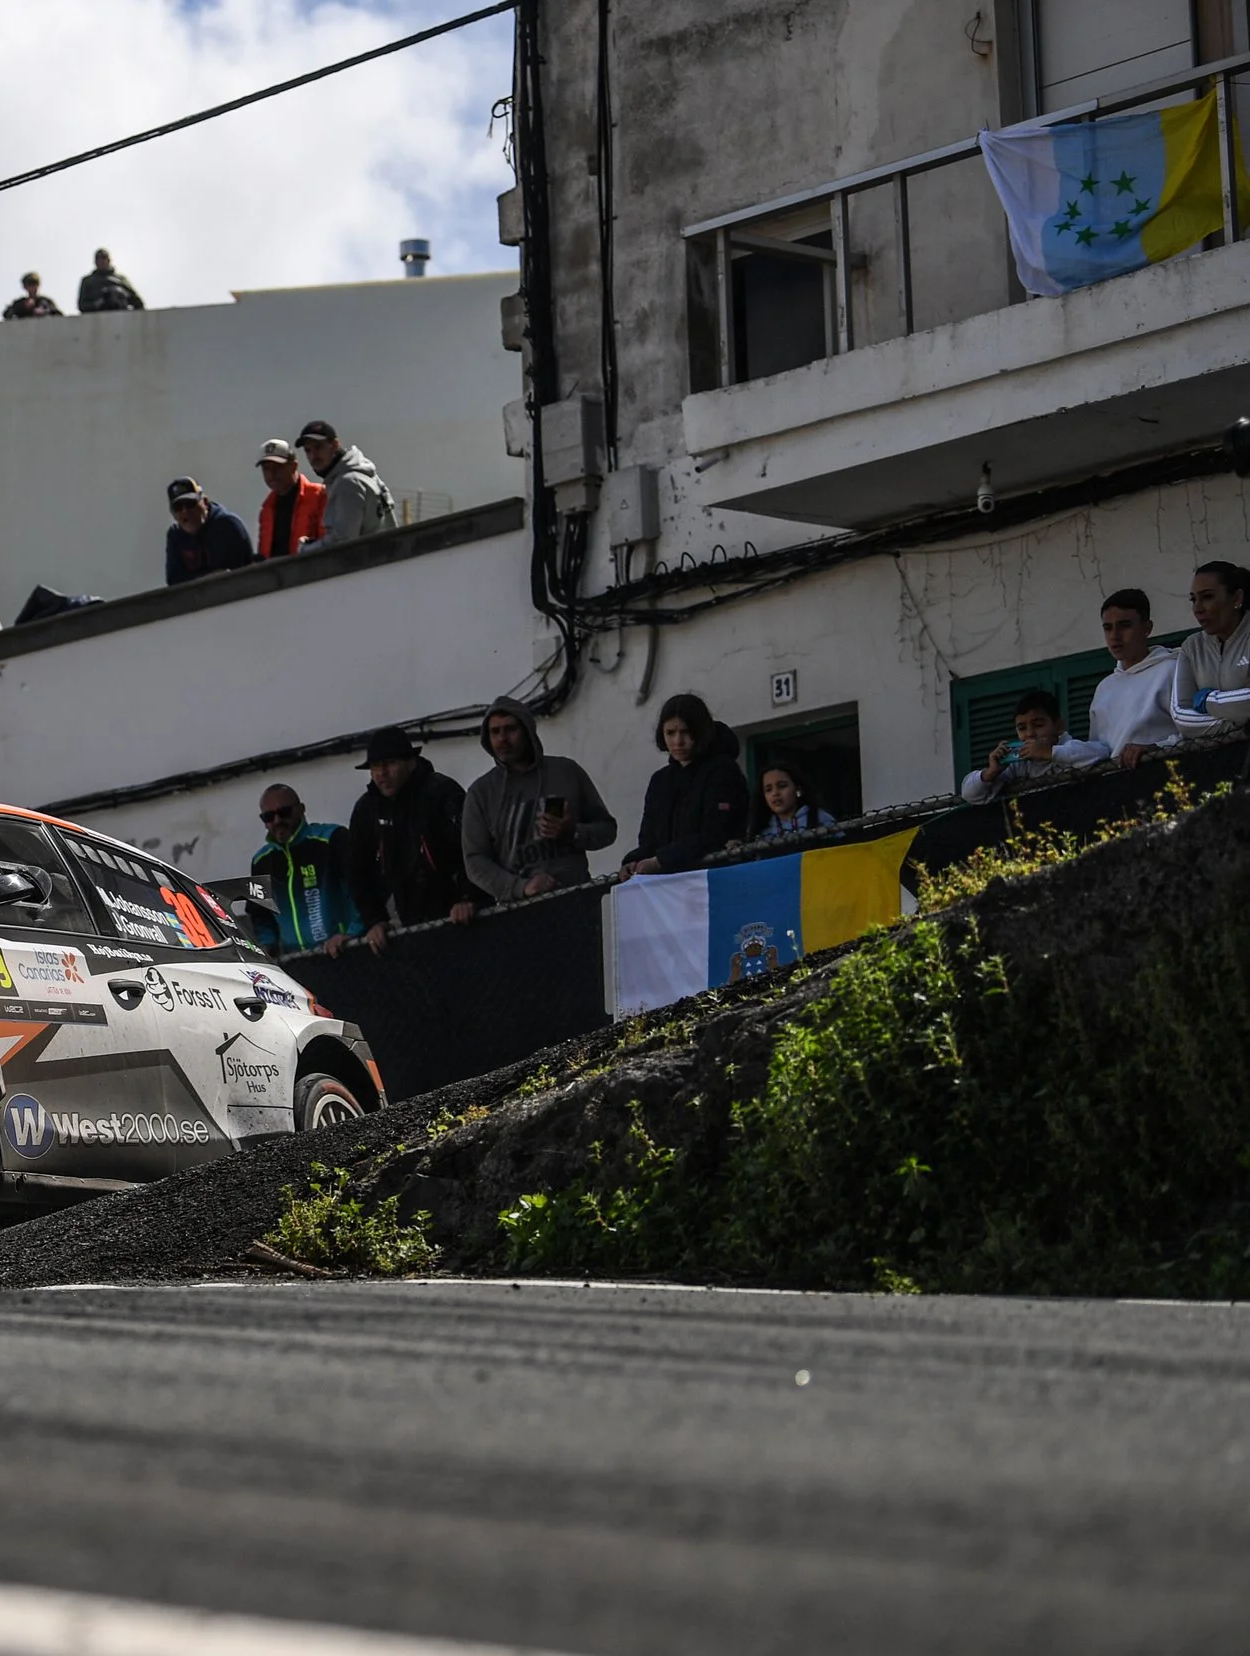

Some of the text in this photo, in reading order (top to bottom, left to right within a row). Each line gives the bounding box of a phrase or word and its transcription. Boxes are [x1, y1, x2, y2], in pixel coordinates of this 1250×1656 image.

[775, 677, 790, 698] 31
[160, 886, 217, 947] 39
[304, 888, 329, 941] CANARIAS
[34, 949, 60, 966] Islas
[18, 963, 66, 982] Canarias
[226, 1056, 280, 1083] Sjötorps
[246, 1080, 267, 1094] Hus
[10, 1104, 210, 1146] W West2000.se
